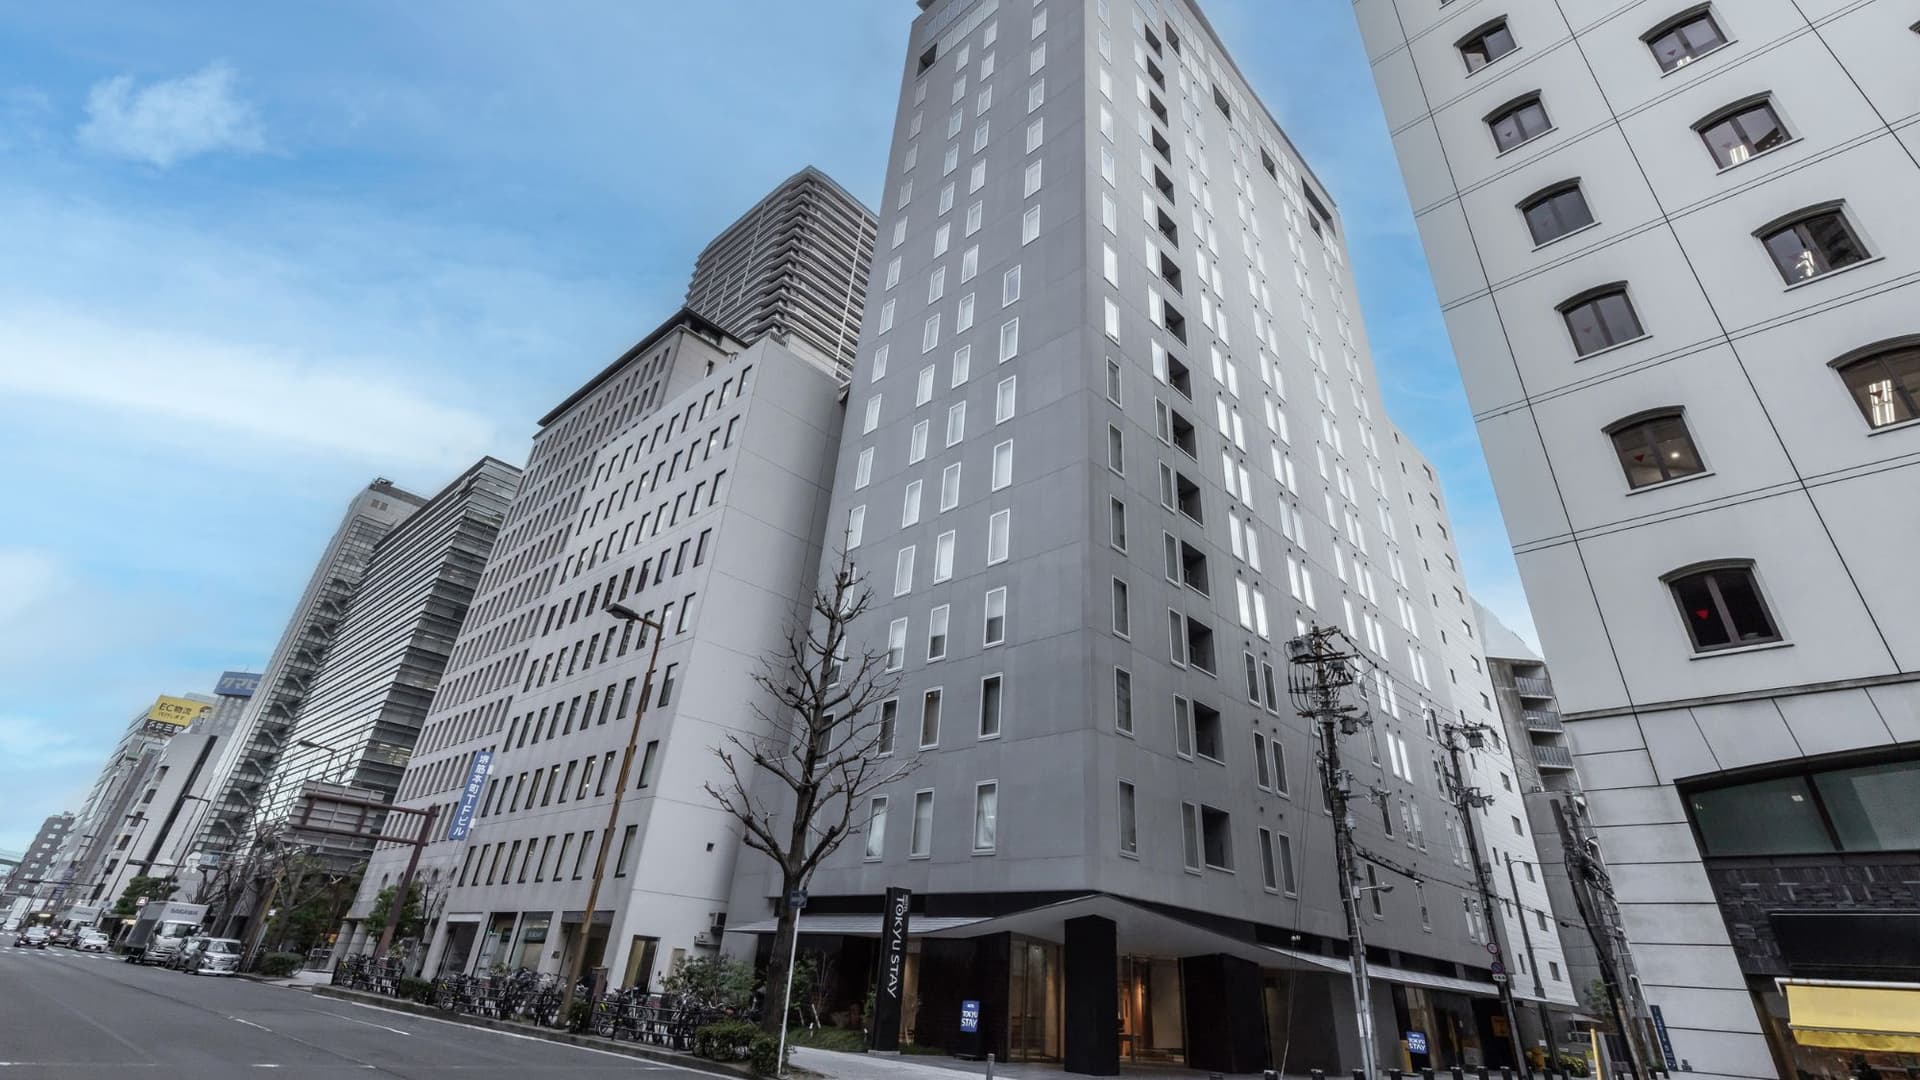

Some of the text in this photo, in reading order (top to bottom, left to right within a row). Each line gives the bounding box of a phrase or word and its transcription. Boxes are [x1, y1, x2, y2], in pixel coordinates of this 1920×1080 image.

[159, 702, 192, 715] EC物流
[887, 894, 905, 999] TOKYU STAY
[961, 1018, 978, 1028] STAY
[1408, 1043, 1426, 1051] STAY
